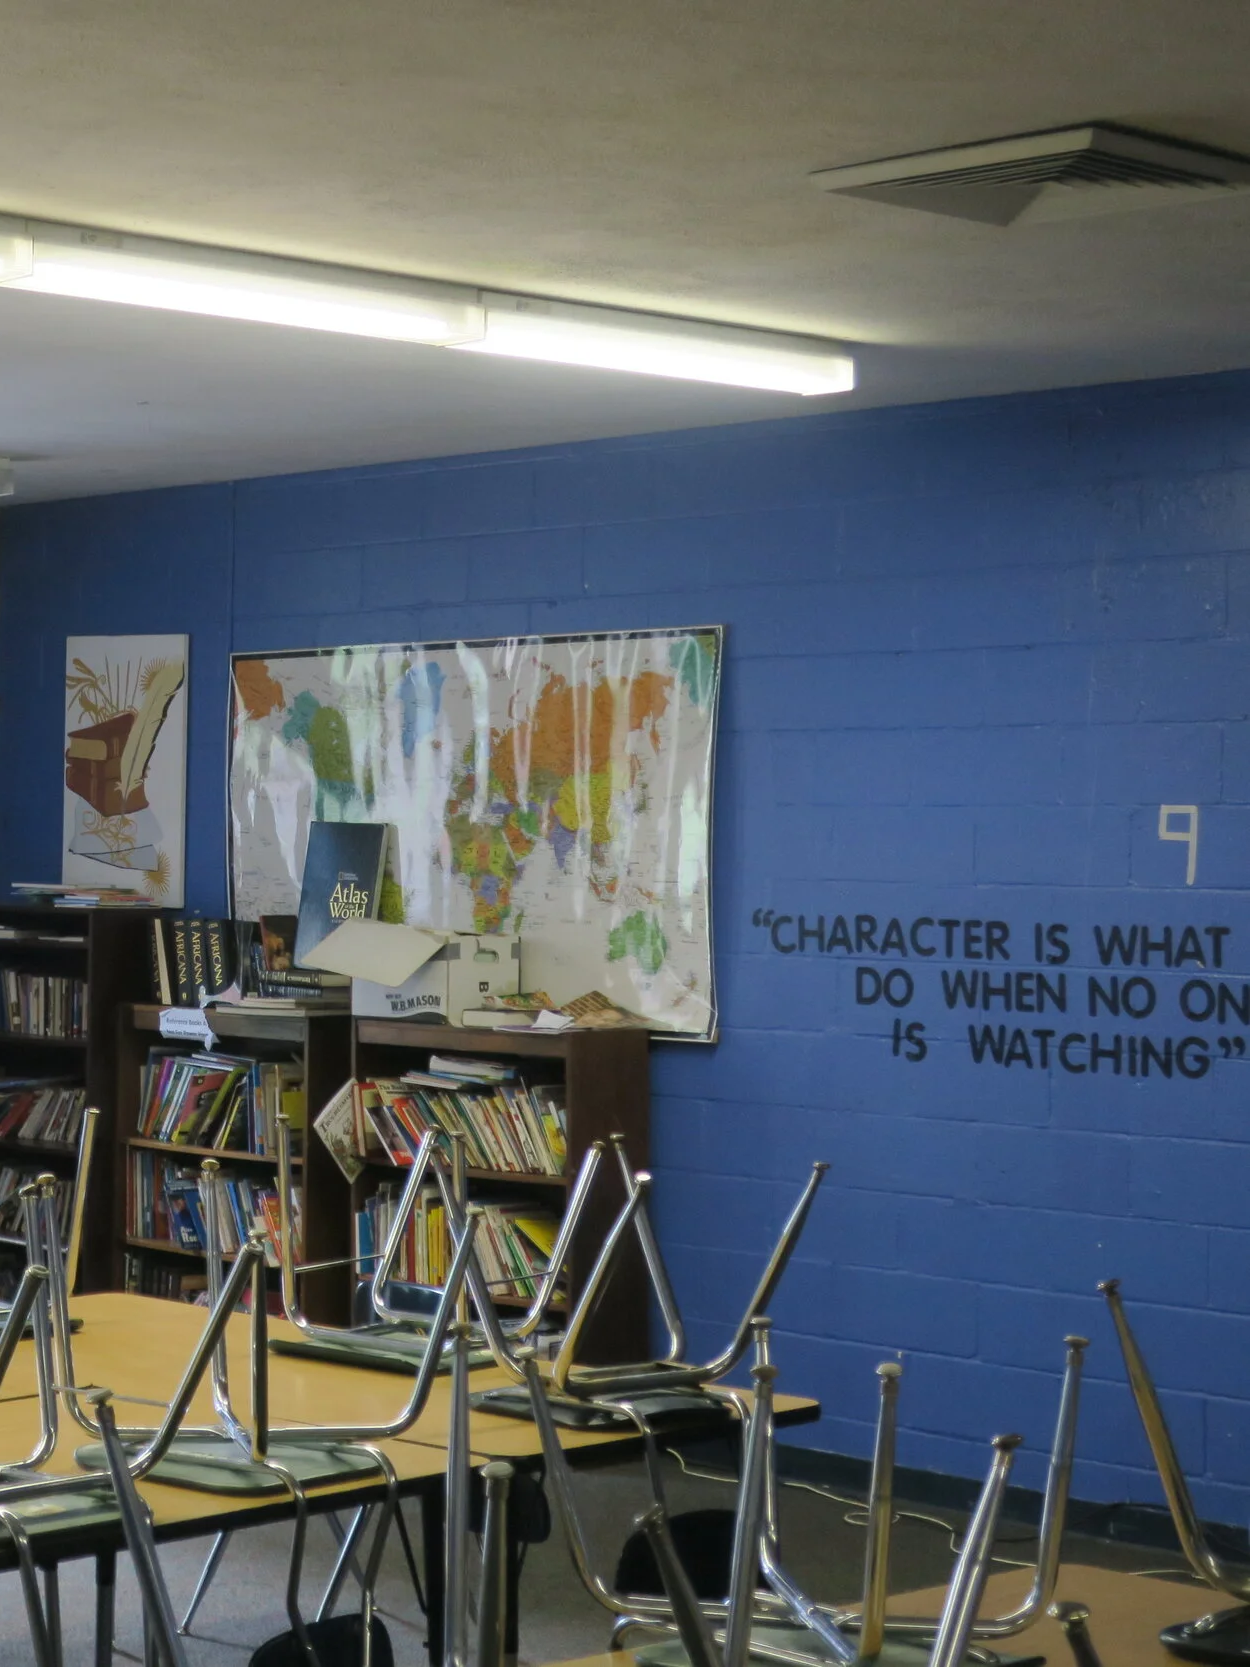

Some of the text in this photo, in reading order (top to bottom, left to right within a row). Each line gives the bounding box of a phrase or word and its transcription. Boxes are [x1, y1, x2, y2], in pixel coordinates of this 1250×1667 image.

[1157, 804, 1199, 886] 9
[329, 882, 369, 904] Atlas
[329, 902, 366, 919] World
[175, 930, 187, 984] AFRICANA
[191, 931, 203, 985] AFRICANA
[209, 933, 223, 987] AFRICANA
[751, 908, 1232, 969] “CHARACTER IS WHAT
[855, 966, 915, 1009] DO
[940, 969, 1067, 1014] WHEN
[1087, 975, 1157, 1019] NO
[891, 1019, 1247, 1080] IS WATCHING”
